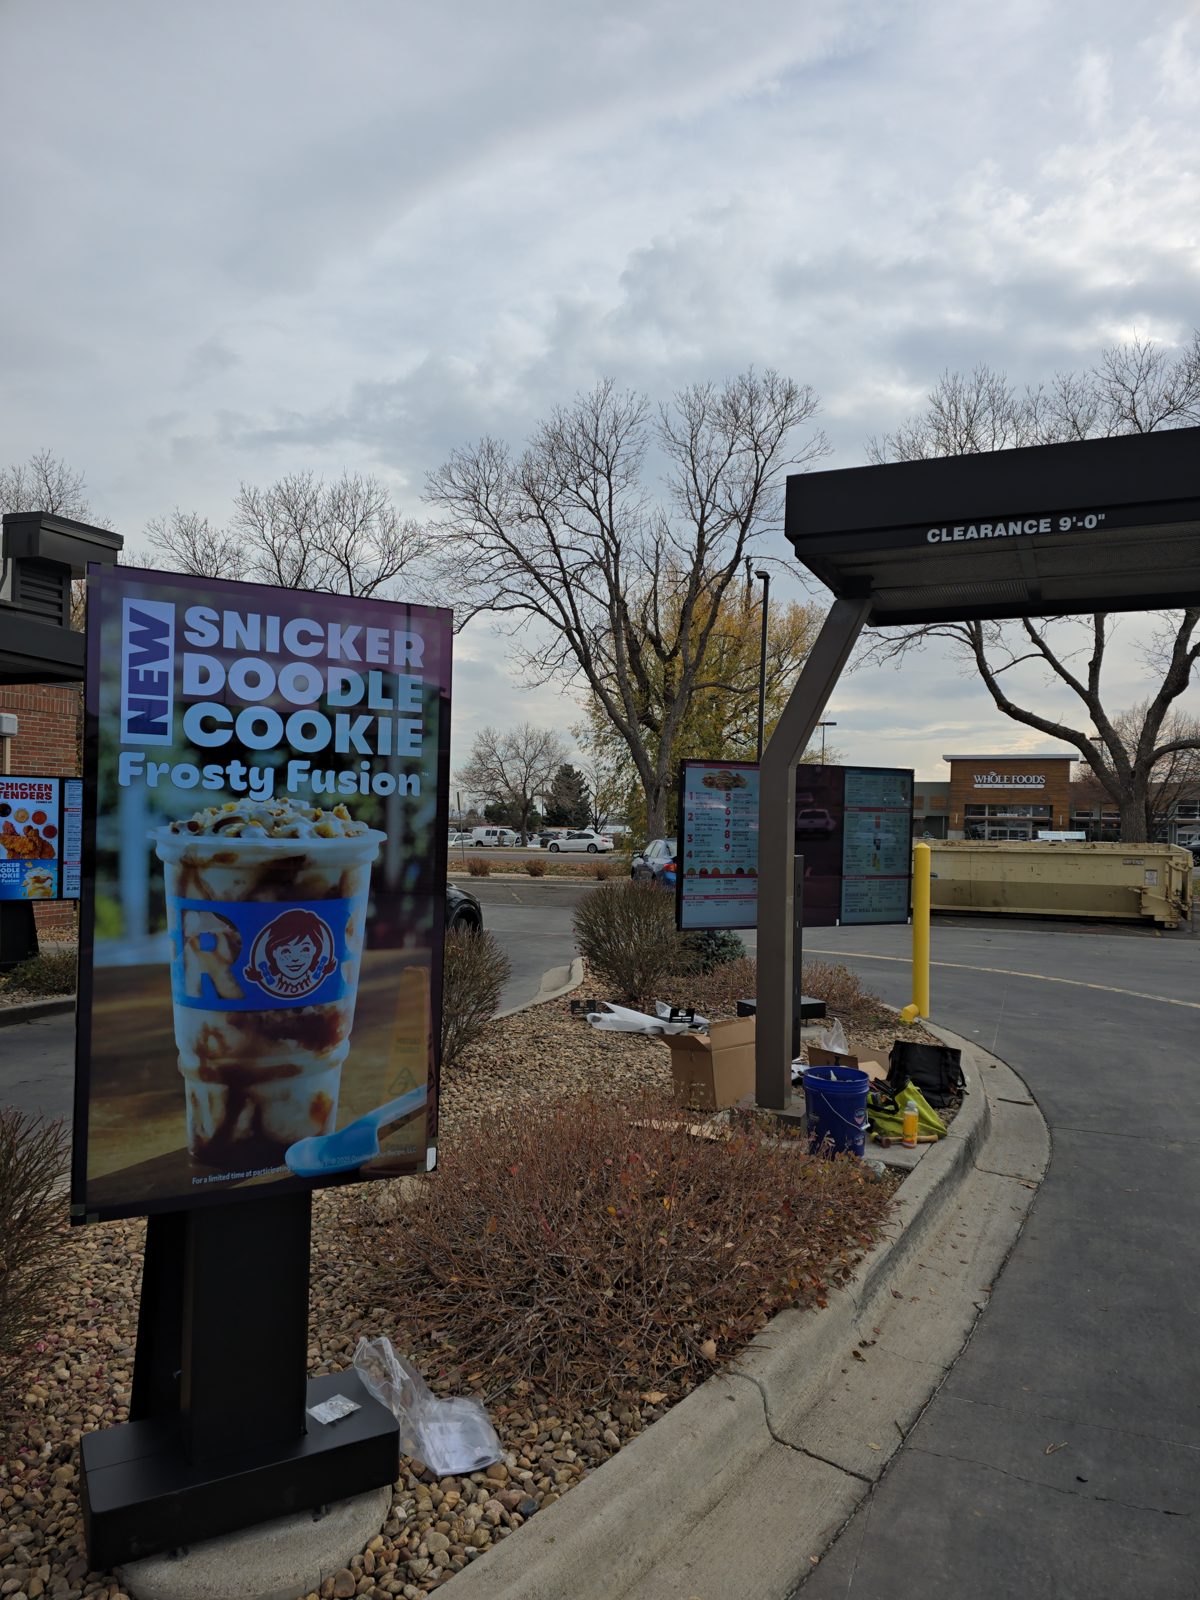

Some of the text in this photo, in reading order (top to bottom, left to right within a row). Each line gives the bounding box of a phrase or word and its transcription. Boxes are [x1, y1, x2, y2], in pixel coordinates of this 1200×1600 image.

[927, 513, 1106, 543] CLEARANCE 9'-0"
[183, 605, 426, 668] SNICKER
[127, 606, 170, 736] NEW
[182, 652, 424, 713] DOODLE
[182, 701, 424, 758] COOKIE
[118, 751, 276, 802] Frosty
[286, 760, 421, 797] Fusion
[974, 772, 1046, 784] WHOLE FOODS
[0, 782, 53, 792] CHICKEN
[725, 792, 732, 801] 5
[725, 807, 732, 815] 6
[687, 812, 694, 821] 2
[725, 819, 731, 828] 7
[687, 834, 693, 843] 3
[725, 830, 731, 838] 8
[724, 844, 731, 852] 9
[208, 1173, 230, 1182] limited
[231, 1171, 244, 1179] time
